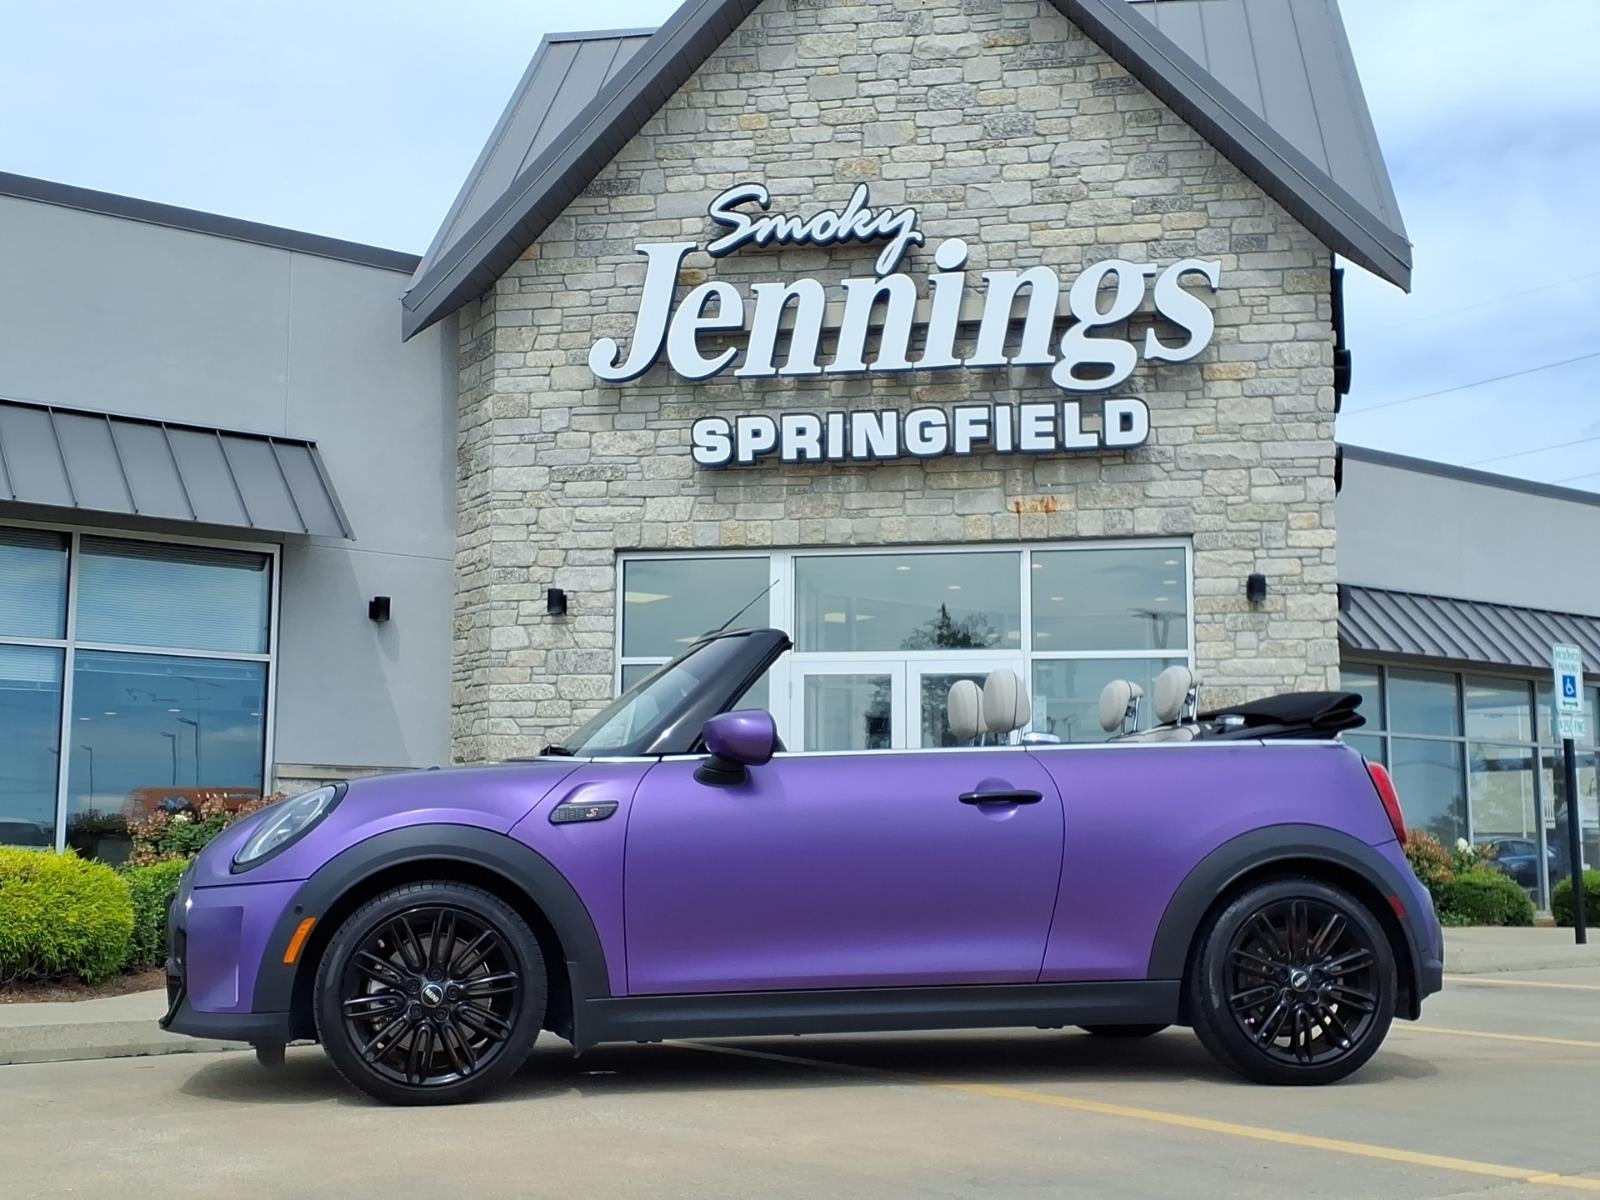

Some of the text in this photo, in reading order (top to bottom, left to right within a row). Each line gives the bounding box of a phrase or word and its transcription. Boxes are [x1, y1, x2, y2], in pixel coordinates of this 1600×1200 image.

[706, 183, 923, 275] Smoky
[588, 237, 1221, 391] Jennings
[691, 397, 1150, 467] SPRINGFIELD
[586, 808, 599, 818] S
